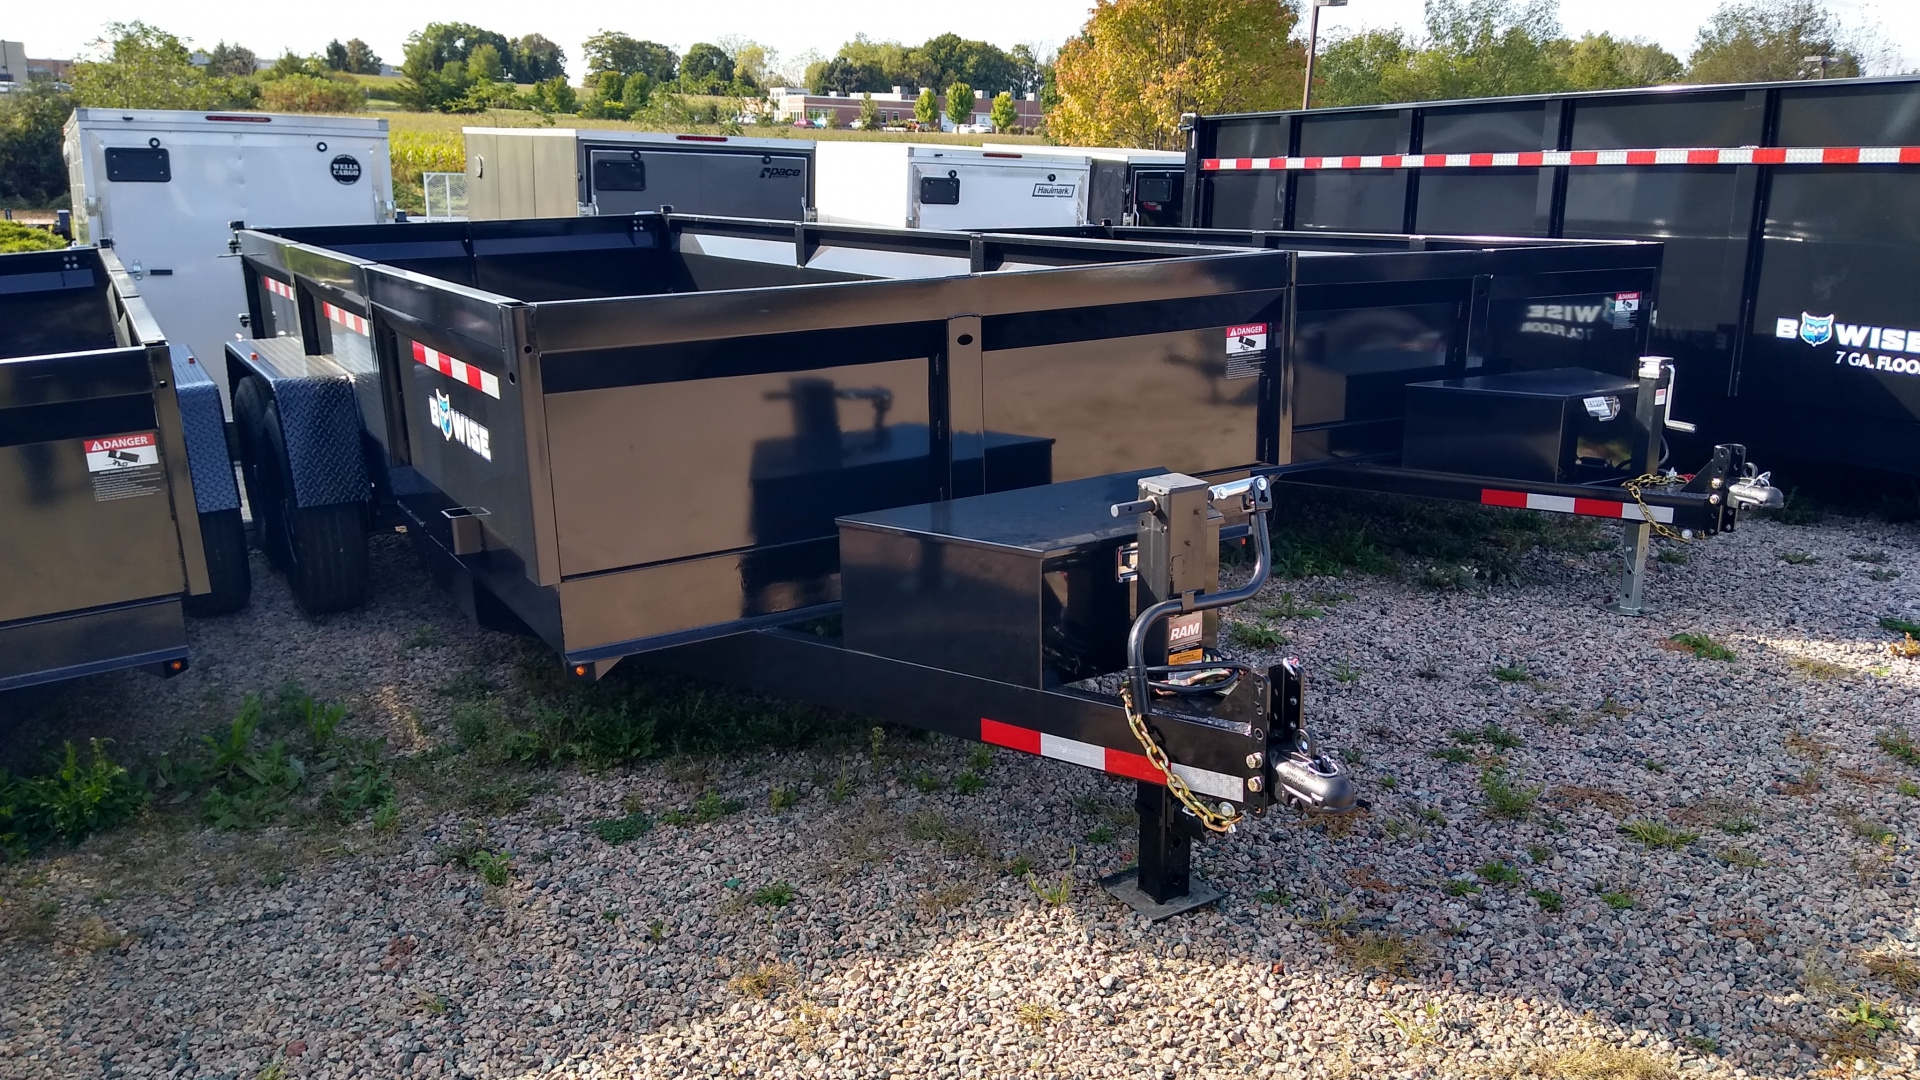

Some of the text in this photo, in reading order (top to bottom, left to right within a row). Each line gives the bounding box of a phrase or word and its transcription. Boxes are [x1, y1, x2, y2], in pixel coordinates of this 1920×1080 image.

[1037, 186, 1070, 195] Haulmark
[1236, 325, 1263, 335] DANGER
[1835, 351, 1920, 375] 7 GA. FLOO
[102, 436, 148, 450] DANGER
[1170, 622, 1201, 641] RAM
